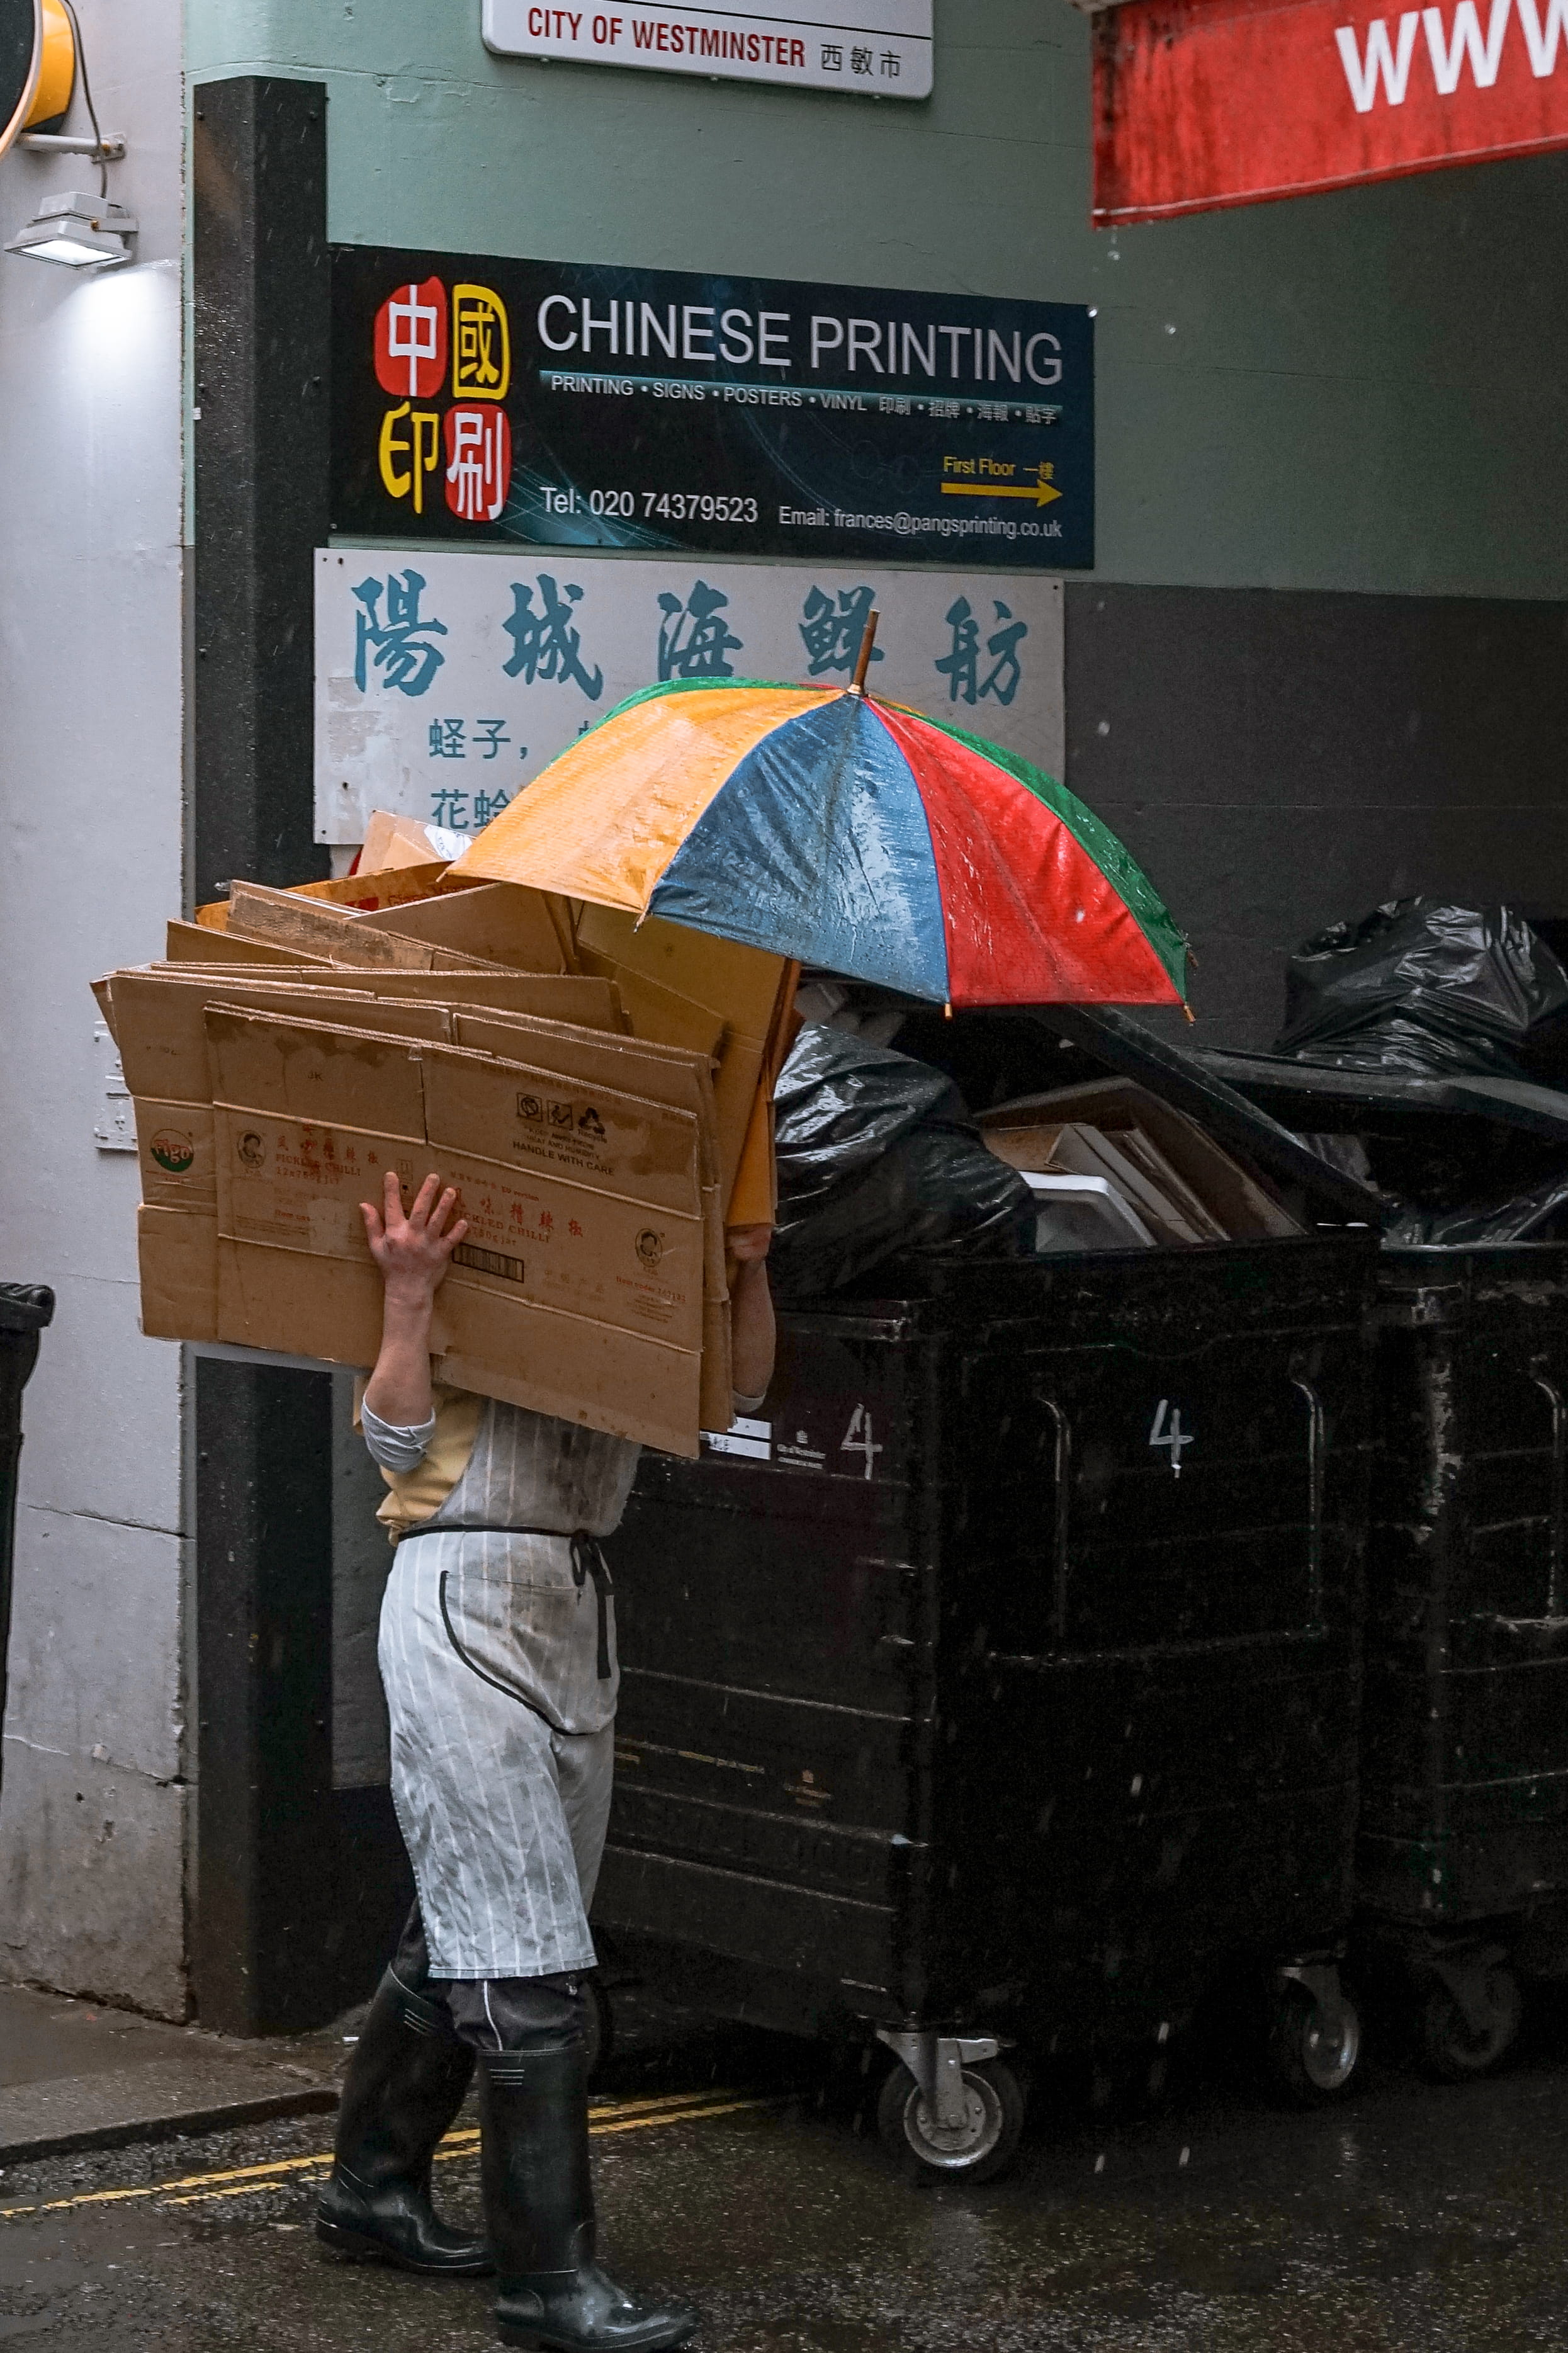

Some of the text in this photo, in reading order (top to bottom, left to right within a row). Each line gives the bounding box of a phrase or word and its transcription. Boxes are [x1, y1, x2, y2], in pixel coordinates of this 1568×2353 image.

[527, 7, 806, 68] CITY OF WESTMINSTER
[821, 42, 902, 79] 西敏市
[388, 283, 510, 400] 中國
[537, 294, 1063, 386] CHINESE PRINTING
[551, 375, 867, 412] PRINTING SIGNS POSTERS VINYL
[379, 400, 504, 521] 印刷
[944, 456, 975, 474] First
[979, 458, 1016, 477] Floor
[539, 486, 759, 523] Tel: 020 74379523
[779, 506, 1064, 540] Email: frances@pangsprinting.co.uk
[512, 1140, 616, 1177] HANDLE WITH CARE
[840, 1403, 883, 1481] 4
[1149, 1398, 1194, 1479] 4
